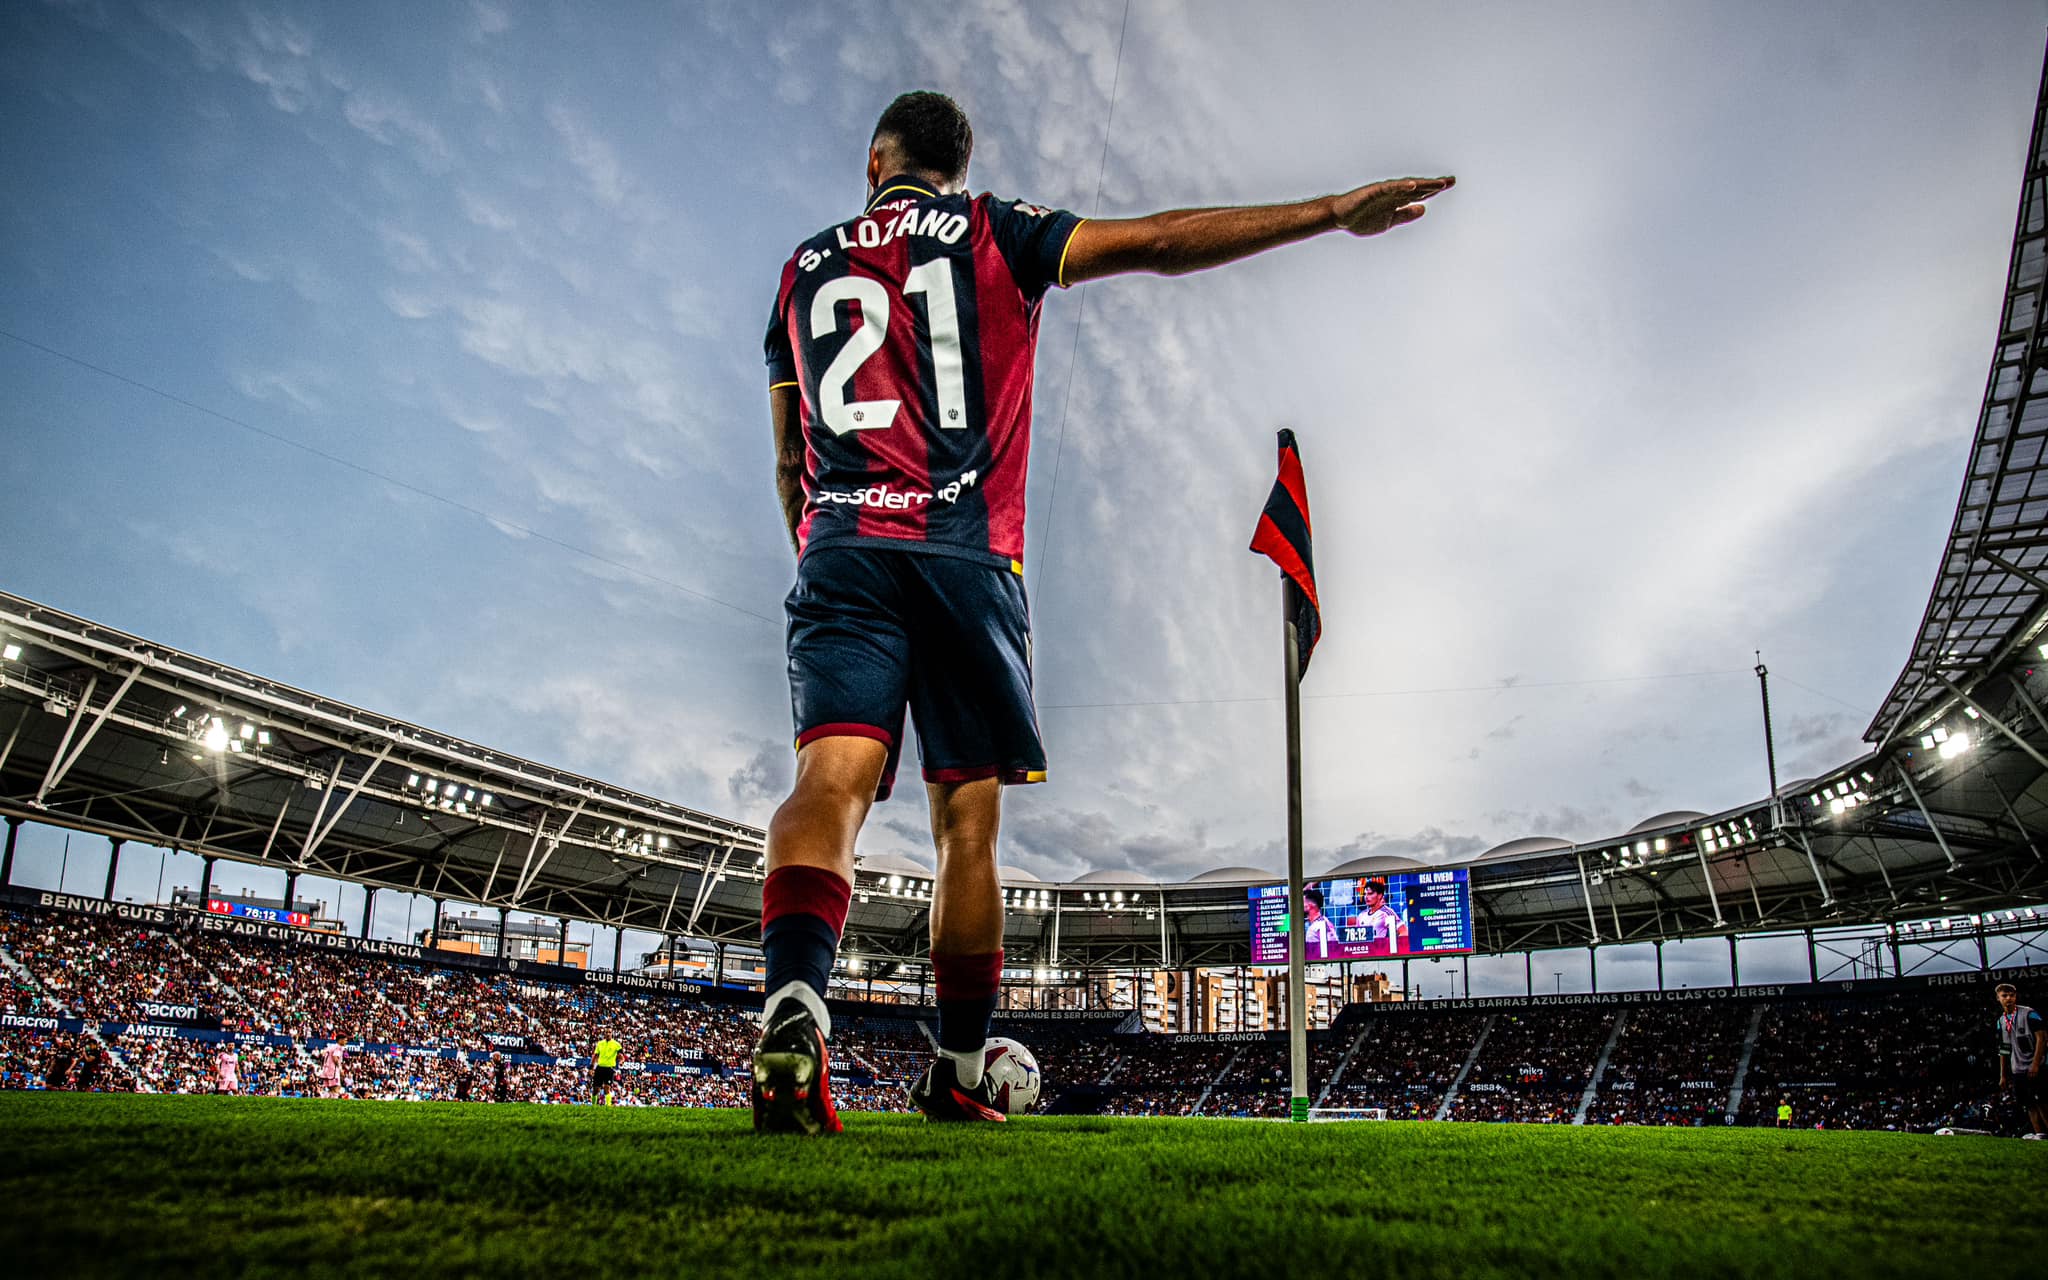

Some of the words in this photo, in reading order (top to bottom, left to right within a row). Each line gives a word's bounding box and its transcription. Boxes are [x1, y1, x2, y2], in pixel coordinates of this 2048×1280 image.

[798, 248, 832, 272] S.
[836, 208, 968, 250] LOZANO
[810, 257, 967, 437] 21
[1419, 872, 1432, 884] REAL
[1434, 872, 1454, 882] OVIEDO
[1261, 886, 1280, 897] LEVANTE
[223, 902, 228, 912] 1
[245, 907, 276, 920] 76:12
[40, 893, 165, 922] BENVINGUTS
[327, 936, 348, 948] DE
[1316, 920, 1328, 958] 1
[1345, 928, 1366, 941] 76:12
[1384, 915, 1397, 954] 1
[585, 972, 613, 983] CLUB
[616, 976, 659, 988] FUNDAT
[662, 981, 675, 991] EN
[678, 983, 701, 994] 1909
[1928, 974, 1976, 986] FIRME
[1981, 970, 2001, 982] TU
[1432, 1001, 1447, 1009] EN
[1452, 1000, 1474, 1008] LAS
[1478, 998, 1528, 1008] BARRAS
[1532, 994, 1618, 1006] AZULGRANAS
[1624, 993, 1640, 1002] DE
[1645, 992, 1661, 1002] TU
[1732, 986, 1785, 998] JERSEY
[1, 1015, 58, 1029] macron
[1012, 1011, 1049, 1019] GRANDE
[1051, 1011, 1062, 1019] ES
[1064, 1011, 1080, 1019] SER
[126, 1024, 178, 1038] AMSTEL
[1175, 1034, 1215, 1043] ORGULL
[1218, 1033, 1266, 1042] GRANOTA
[674, 1066, 700, 1074] macron
